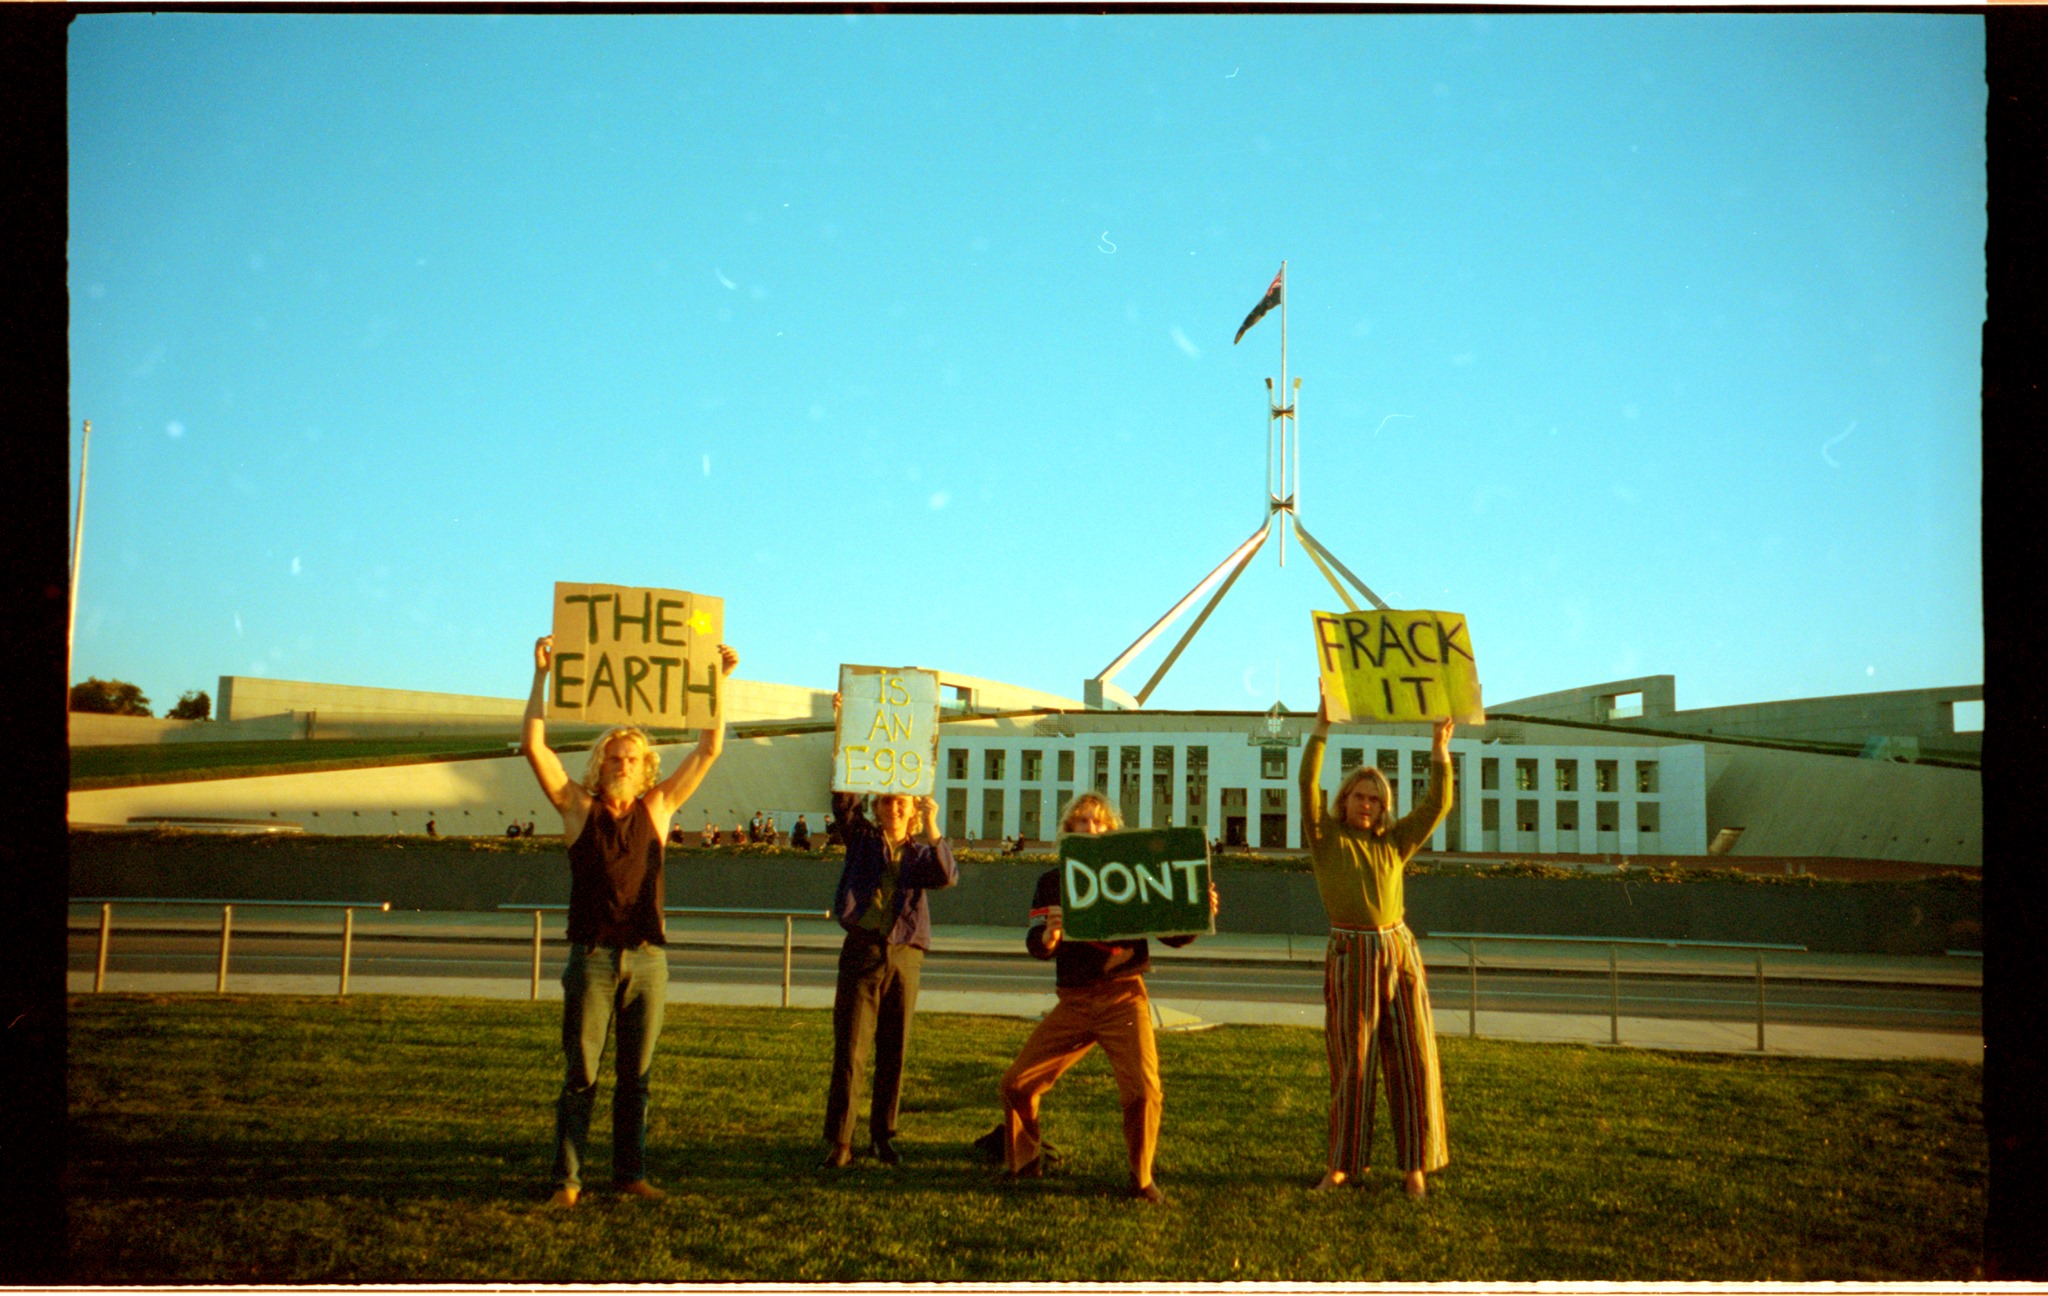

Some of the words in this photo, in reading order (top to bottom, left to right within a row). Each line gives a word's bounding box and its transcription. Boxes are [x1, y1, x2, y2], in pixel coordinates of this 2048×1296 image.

[564, 592, 687, 647] THE
[1316, 615, 1475, 673] FRACK
[554, 651, 718, 718] EARTH
[1381, 676, 1434, 716] IT
[868, 709, 913, 742] AN
[1065, 857, 1208, 909] DONT
